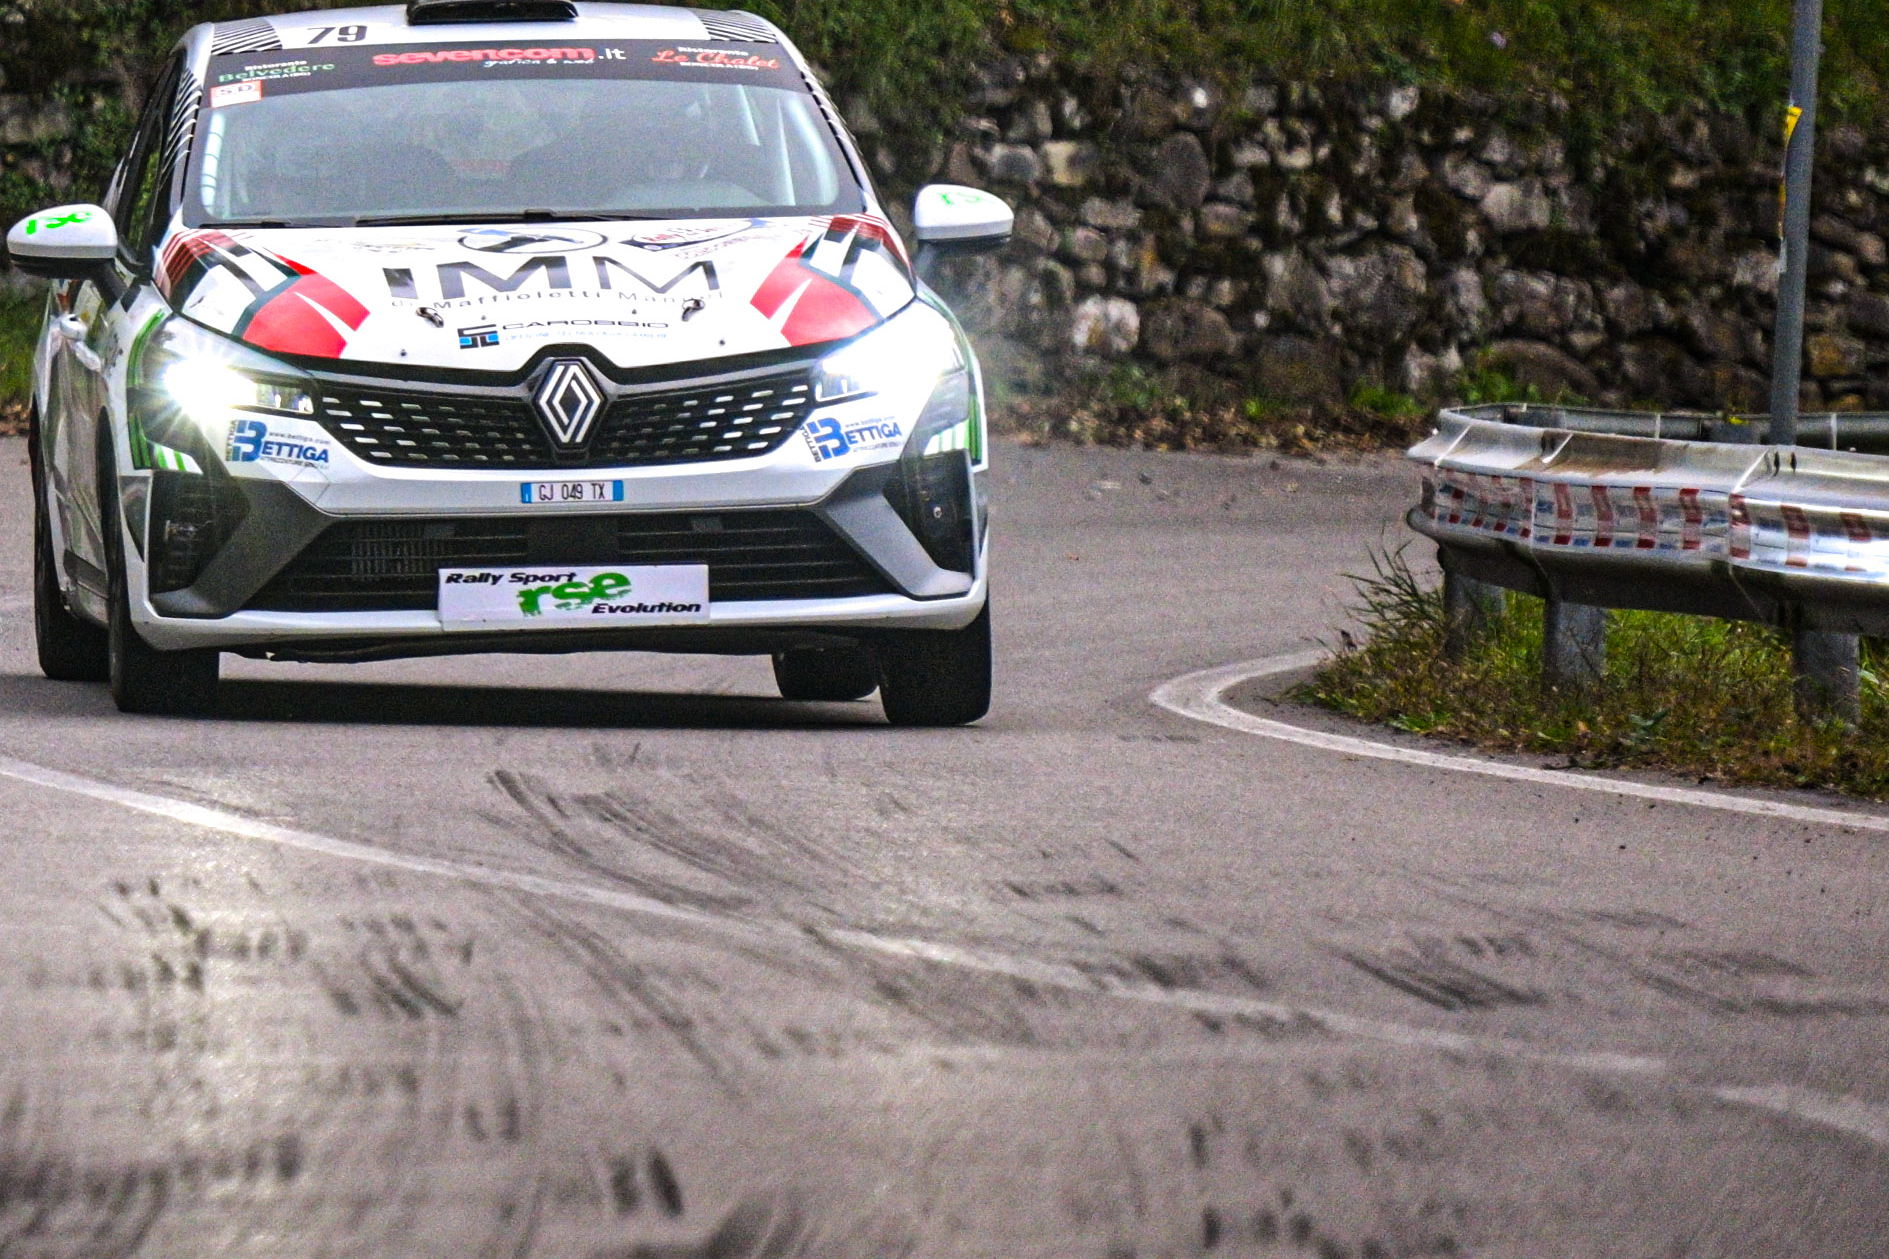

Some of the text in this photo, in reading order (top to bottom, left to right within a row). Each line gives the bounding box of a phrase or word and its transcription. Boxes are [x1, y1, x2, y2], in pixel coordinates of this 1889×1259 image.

[307, 25, 367, 45] 79
[651, 49, 781, 69] Le Chalet
[218, 62, 336, 83] Belvedere
[382, 254, 721, 301] IMM
[433, 290, 602, 309] Maffioletti
[502, 318, 669, 330] CAROBBIO
[231, 420, 330, 463] BETTIGA
[538, 483, 606, 501] GJ 049 TX
[445, 571, 577, 585] Rally Sport
[515, 572, 633, 618] rse
[591, 601, 703, 615] Evolution
